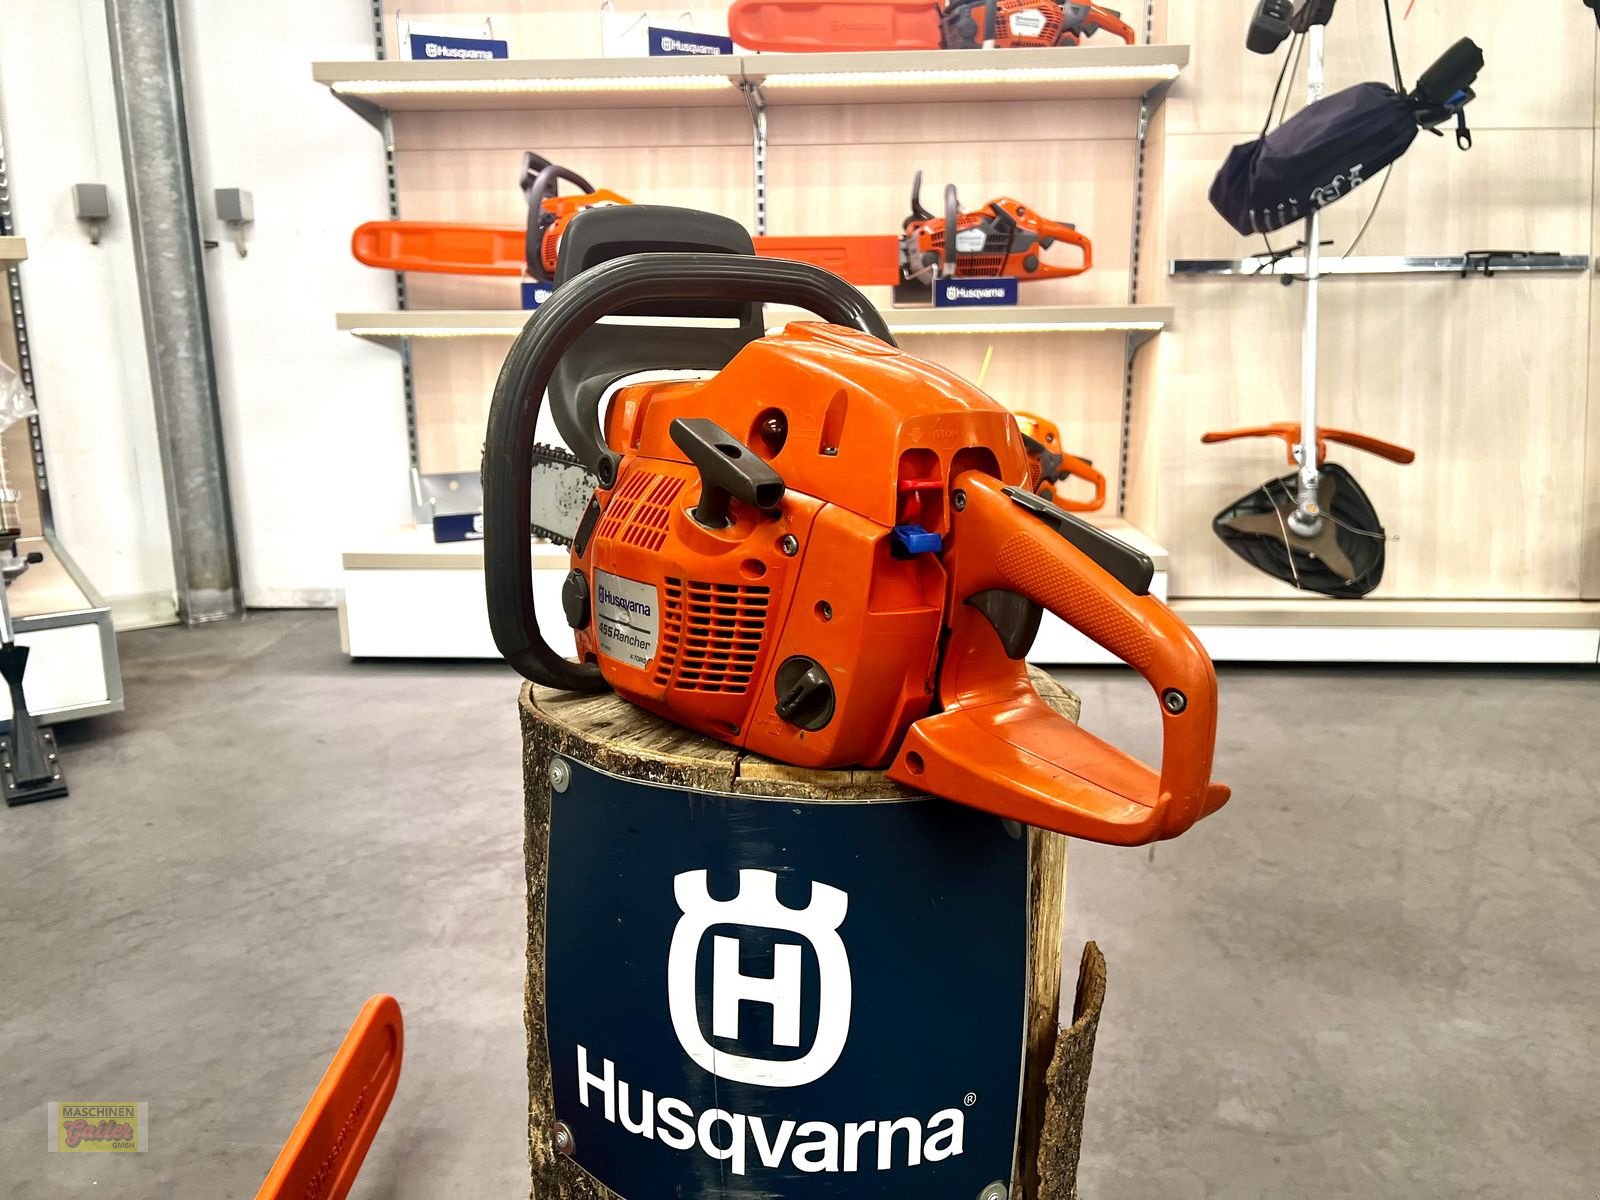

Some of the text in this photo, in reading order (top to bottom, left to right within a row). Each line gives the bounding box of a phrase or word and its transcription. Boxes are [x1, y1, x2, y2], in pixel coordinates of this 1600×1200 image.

[438, 45, 493, 59] Husqvarna
[672, 39, 720, 54] Husqvarna
[956, 287, 1005, 299] Husqvarna
[605, 589, 651, 616] Husqvarna
[599, 622, 613, 637] 455
[613, 630, 651, 650] Rancher
